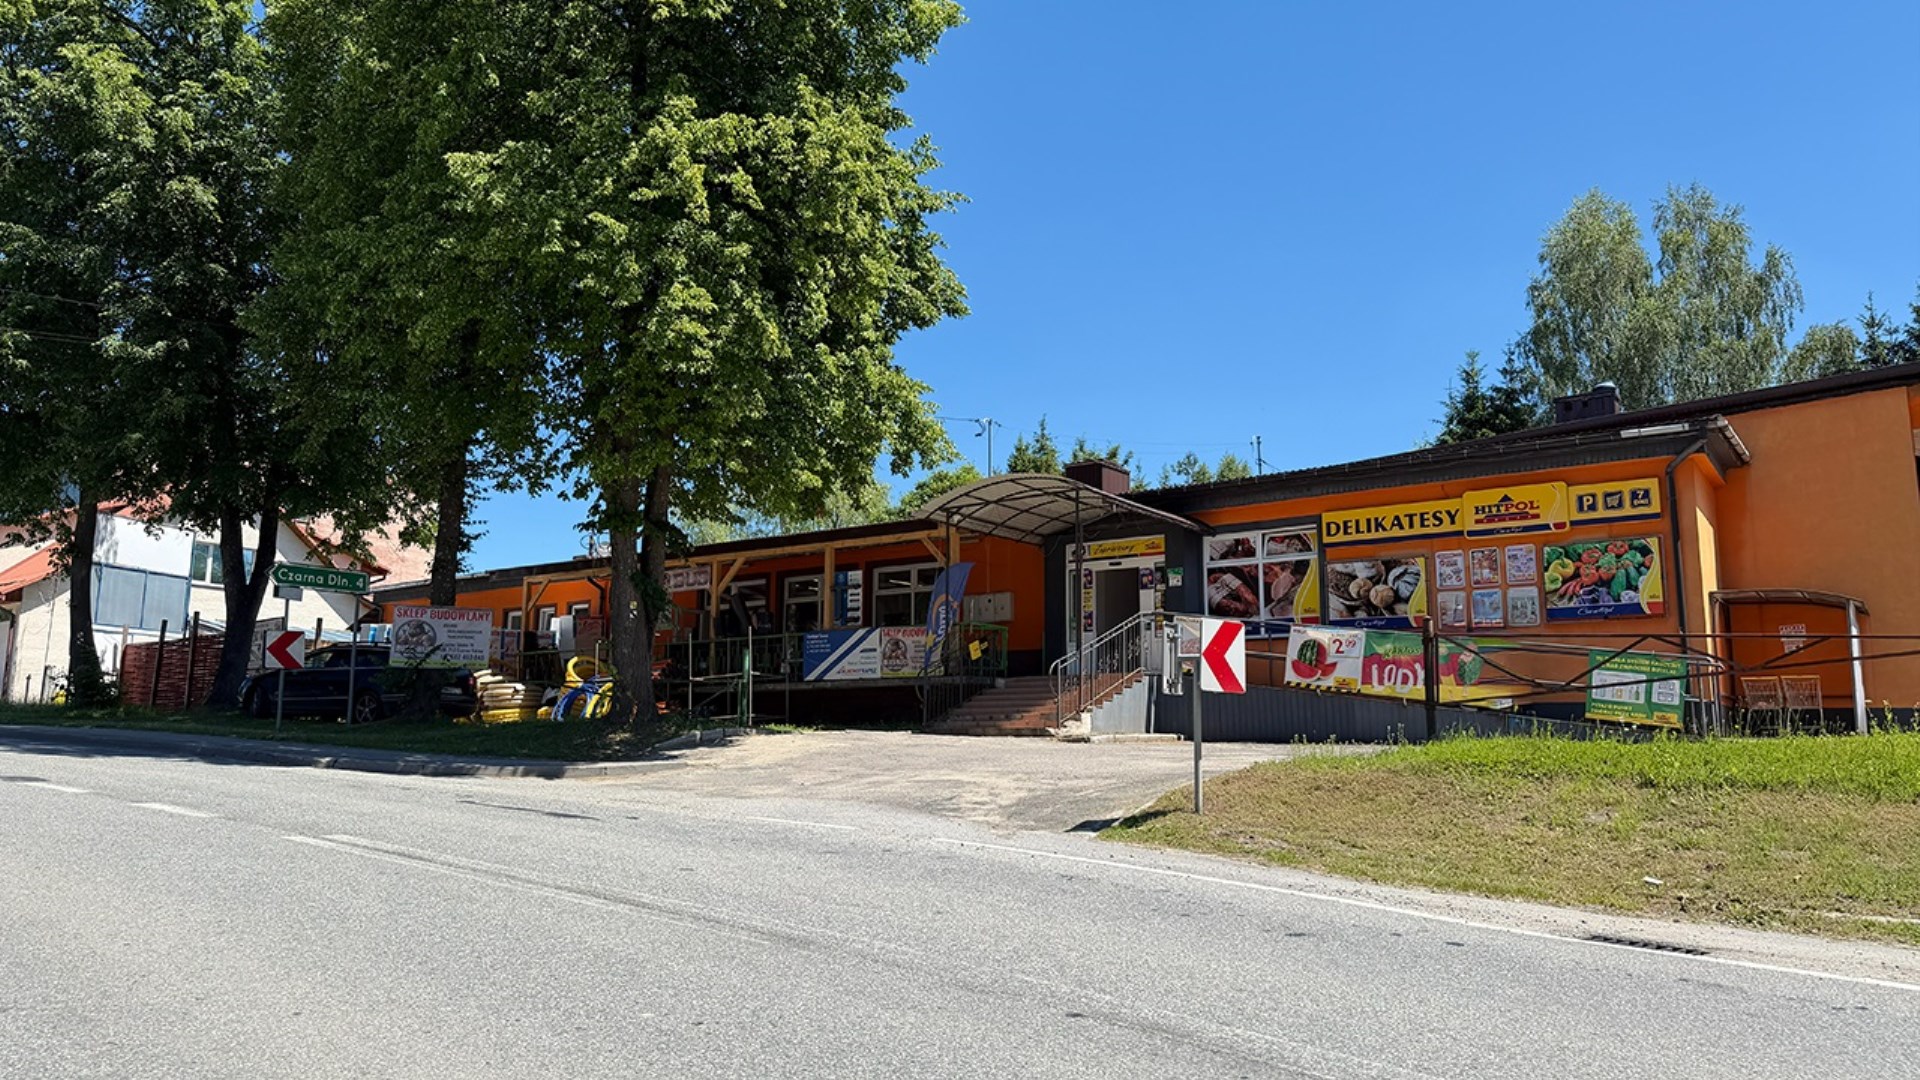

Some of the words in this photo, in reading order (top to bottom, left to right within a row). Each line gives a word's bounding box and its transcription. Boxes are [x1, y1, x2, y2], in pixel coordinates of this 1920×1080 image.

[1636, 490, 1645, 499] 7
[1473, 500, 1540, 516] HITPOL
[1582, 495, 1593, 511] P
[1325, 509, 1461, 538] DELIKATESY
[278, 568, 324, 584] Czarna
[328, 574, 353, 587] Dln.
[356, 578, 364, 589] 4
[397, 607, 428, 619] SKLEP
[430, 609, 491, 621] BUDOWLANY
[1332, 638, 1345, 655] 2
